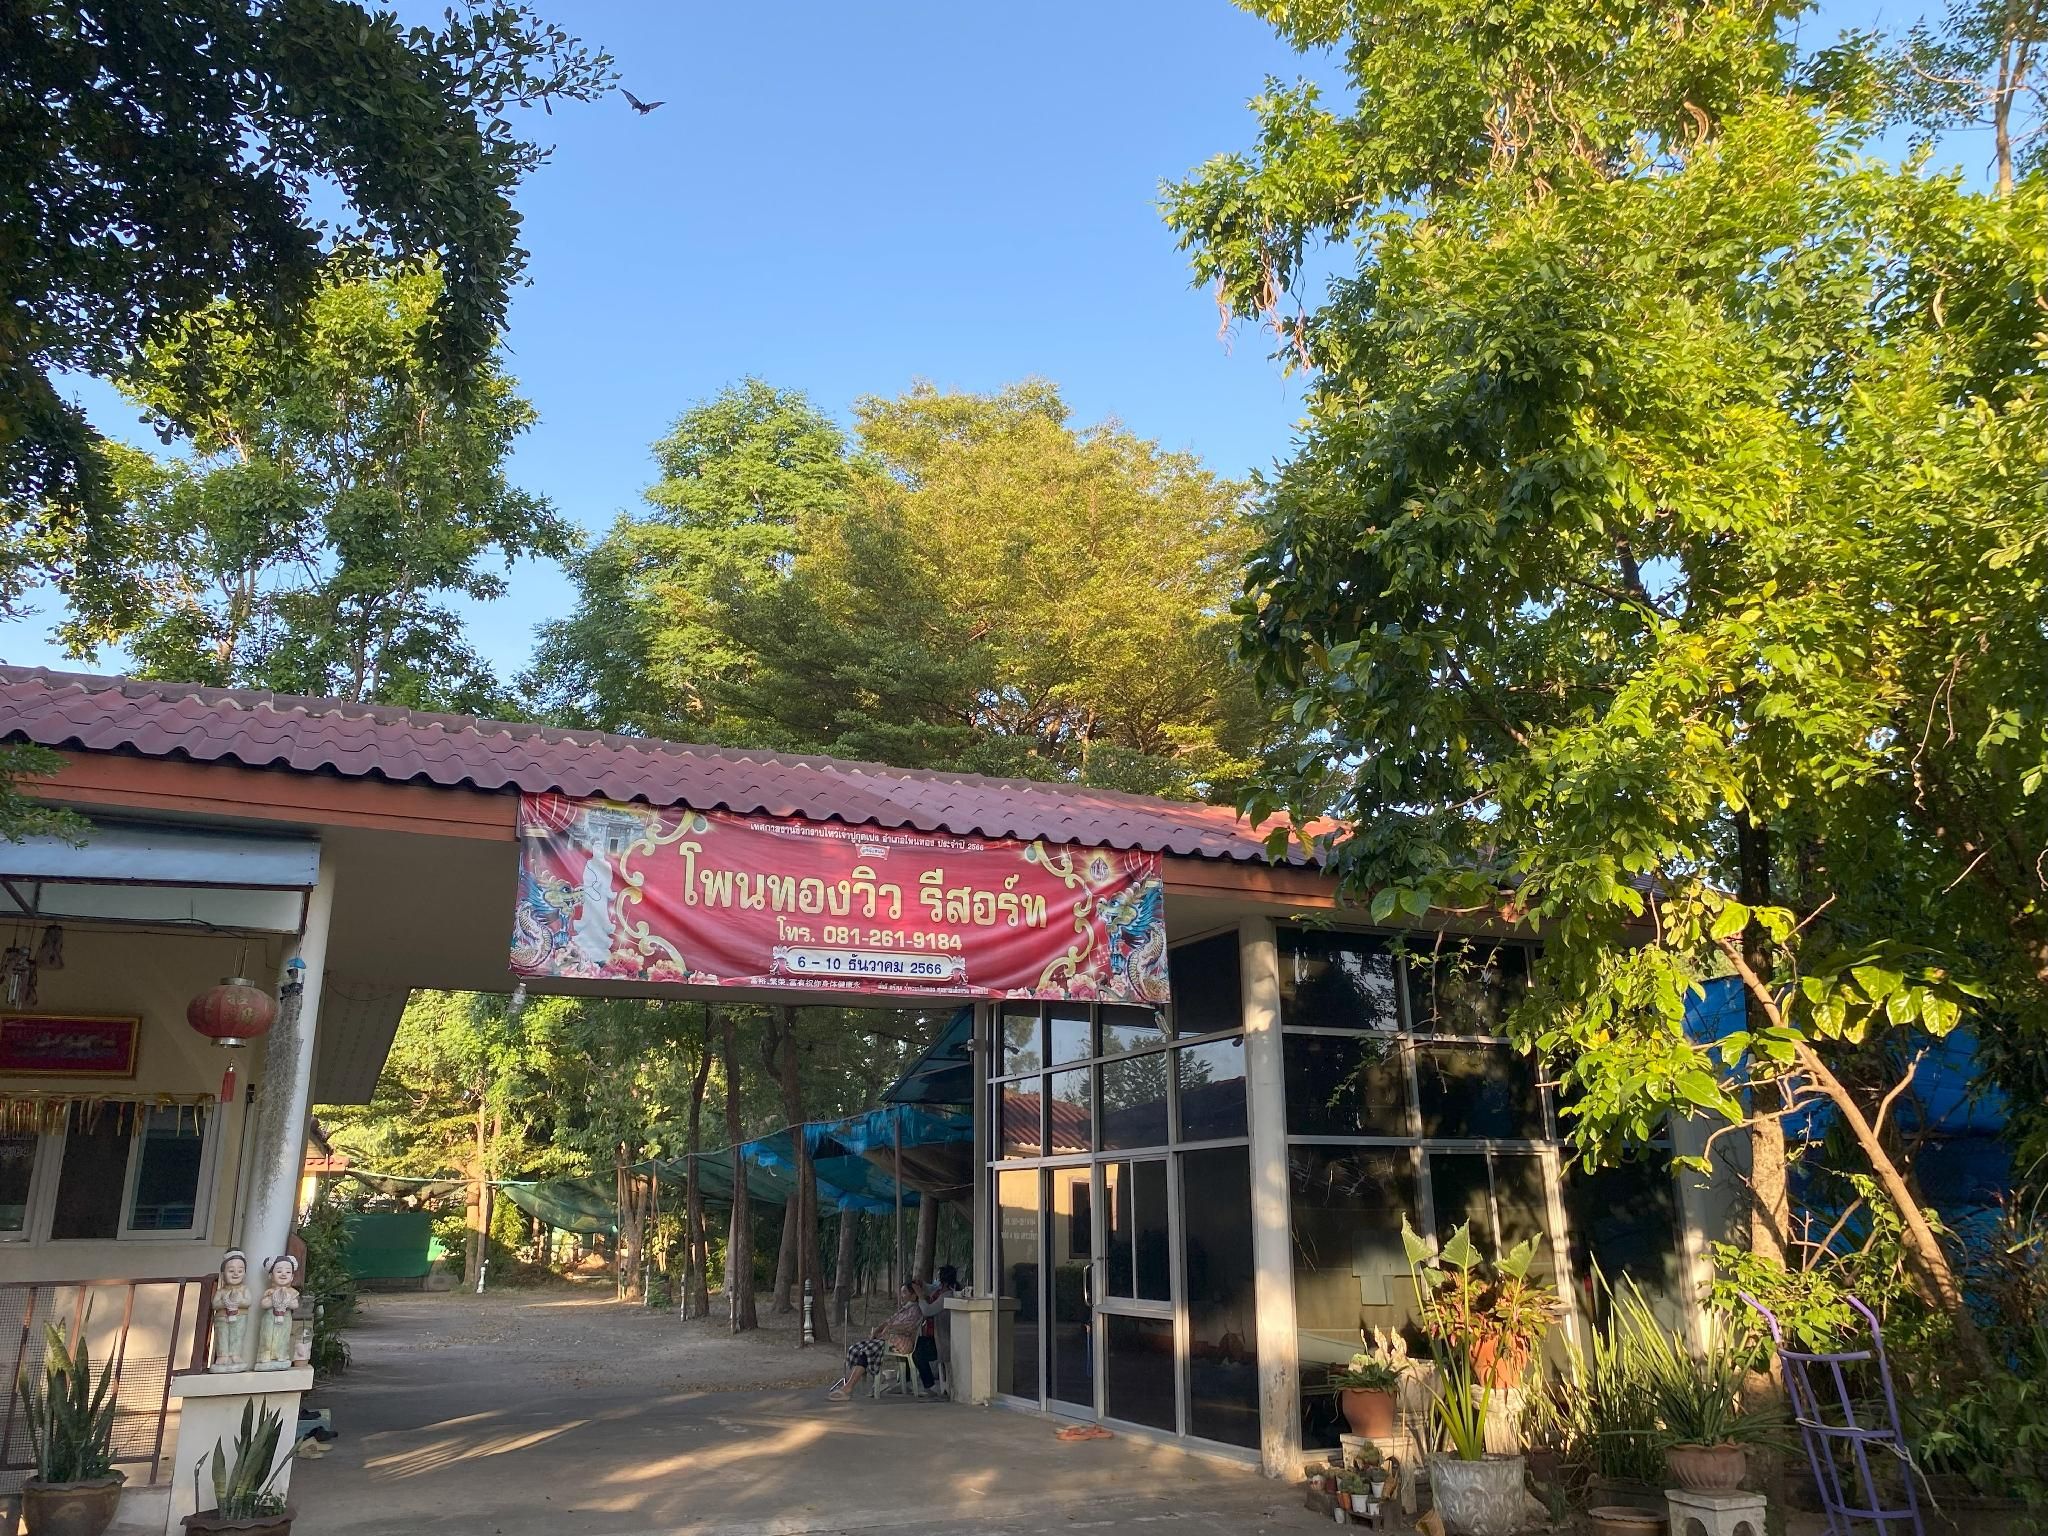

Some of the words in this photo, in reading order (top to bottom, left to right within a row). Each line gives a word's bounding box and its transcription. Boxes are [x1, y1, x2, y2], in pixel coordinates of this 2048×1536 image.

[679, 841, 901, 919] โพนทองวิว
[919, 868, 1047, 928] รีสอร์ท
[776, 916, 815, 942] โทร.
[823, 925, 962, 950] 081-261-9184
[797, 956, 806, 968] 6
[826, 958, 841, 970] 10
[848, 953, 903, 973] ธันวาคม
[910, 962, 942, 974] 2566
